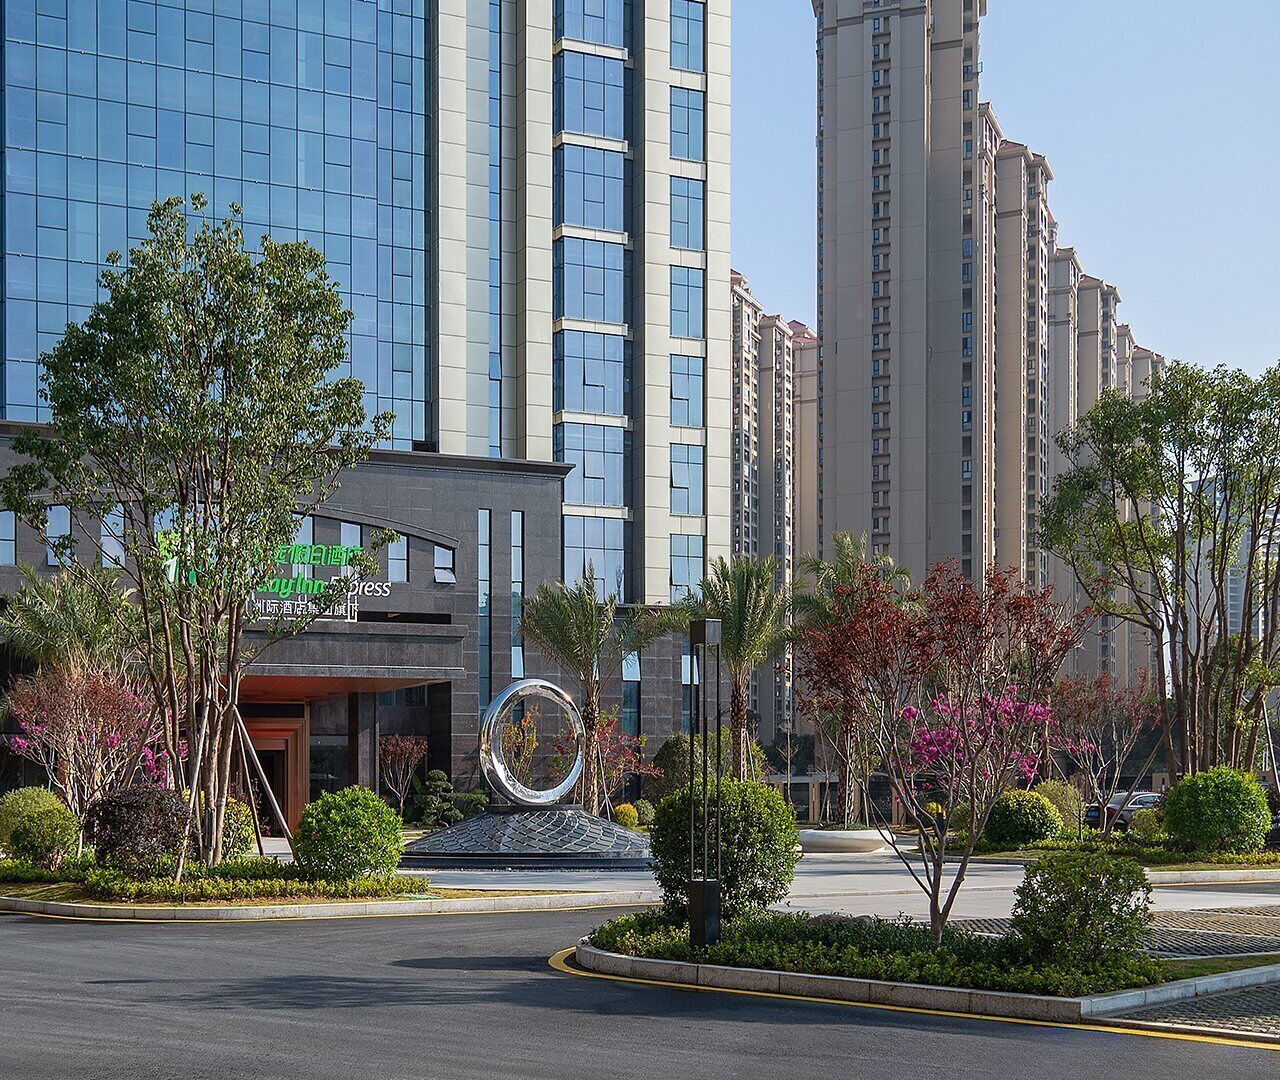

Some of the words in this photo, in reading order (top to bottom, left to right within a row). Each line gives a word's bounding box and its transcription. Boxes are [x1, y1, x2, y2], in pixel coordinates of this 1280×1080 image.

[252, 543, 364, 566] 选假日酒
[326, 576, 392, 598] Epress
